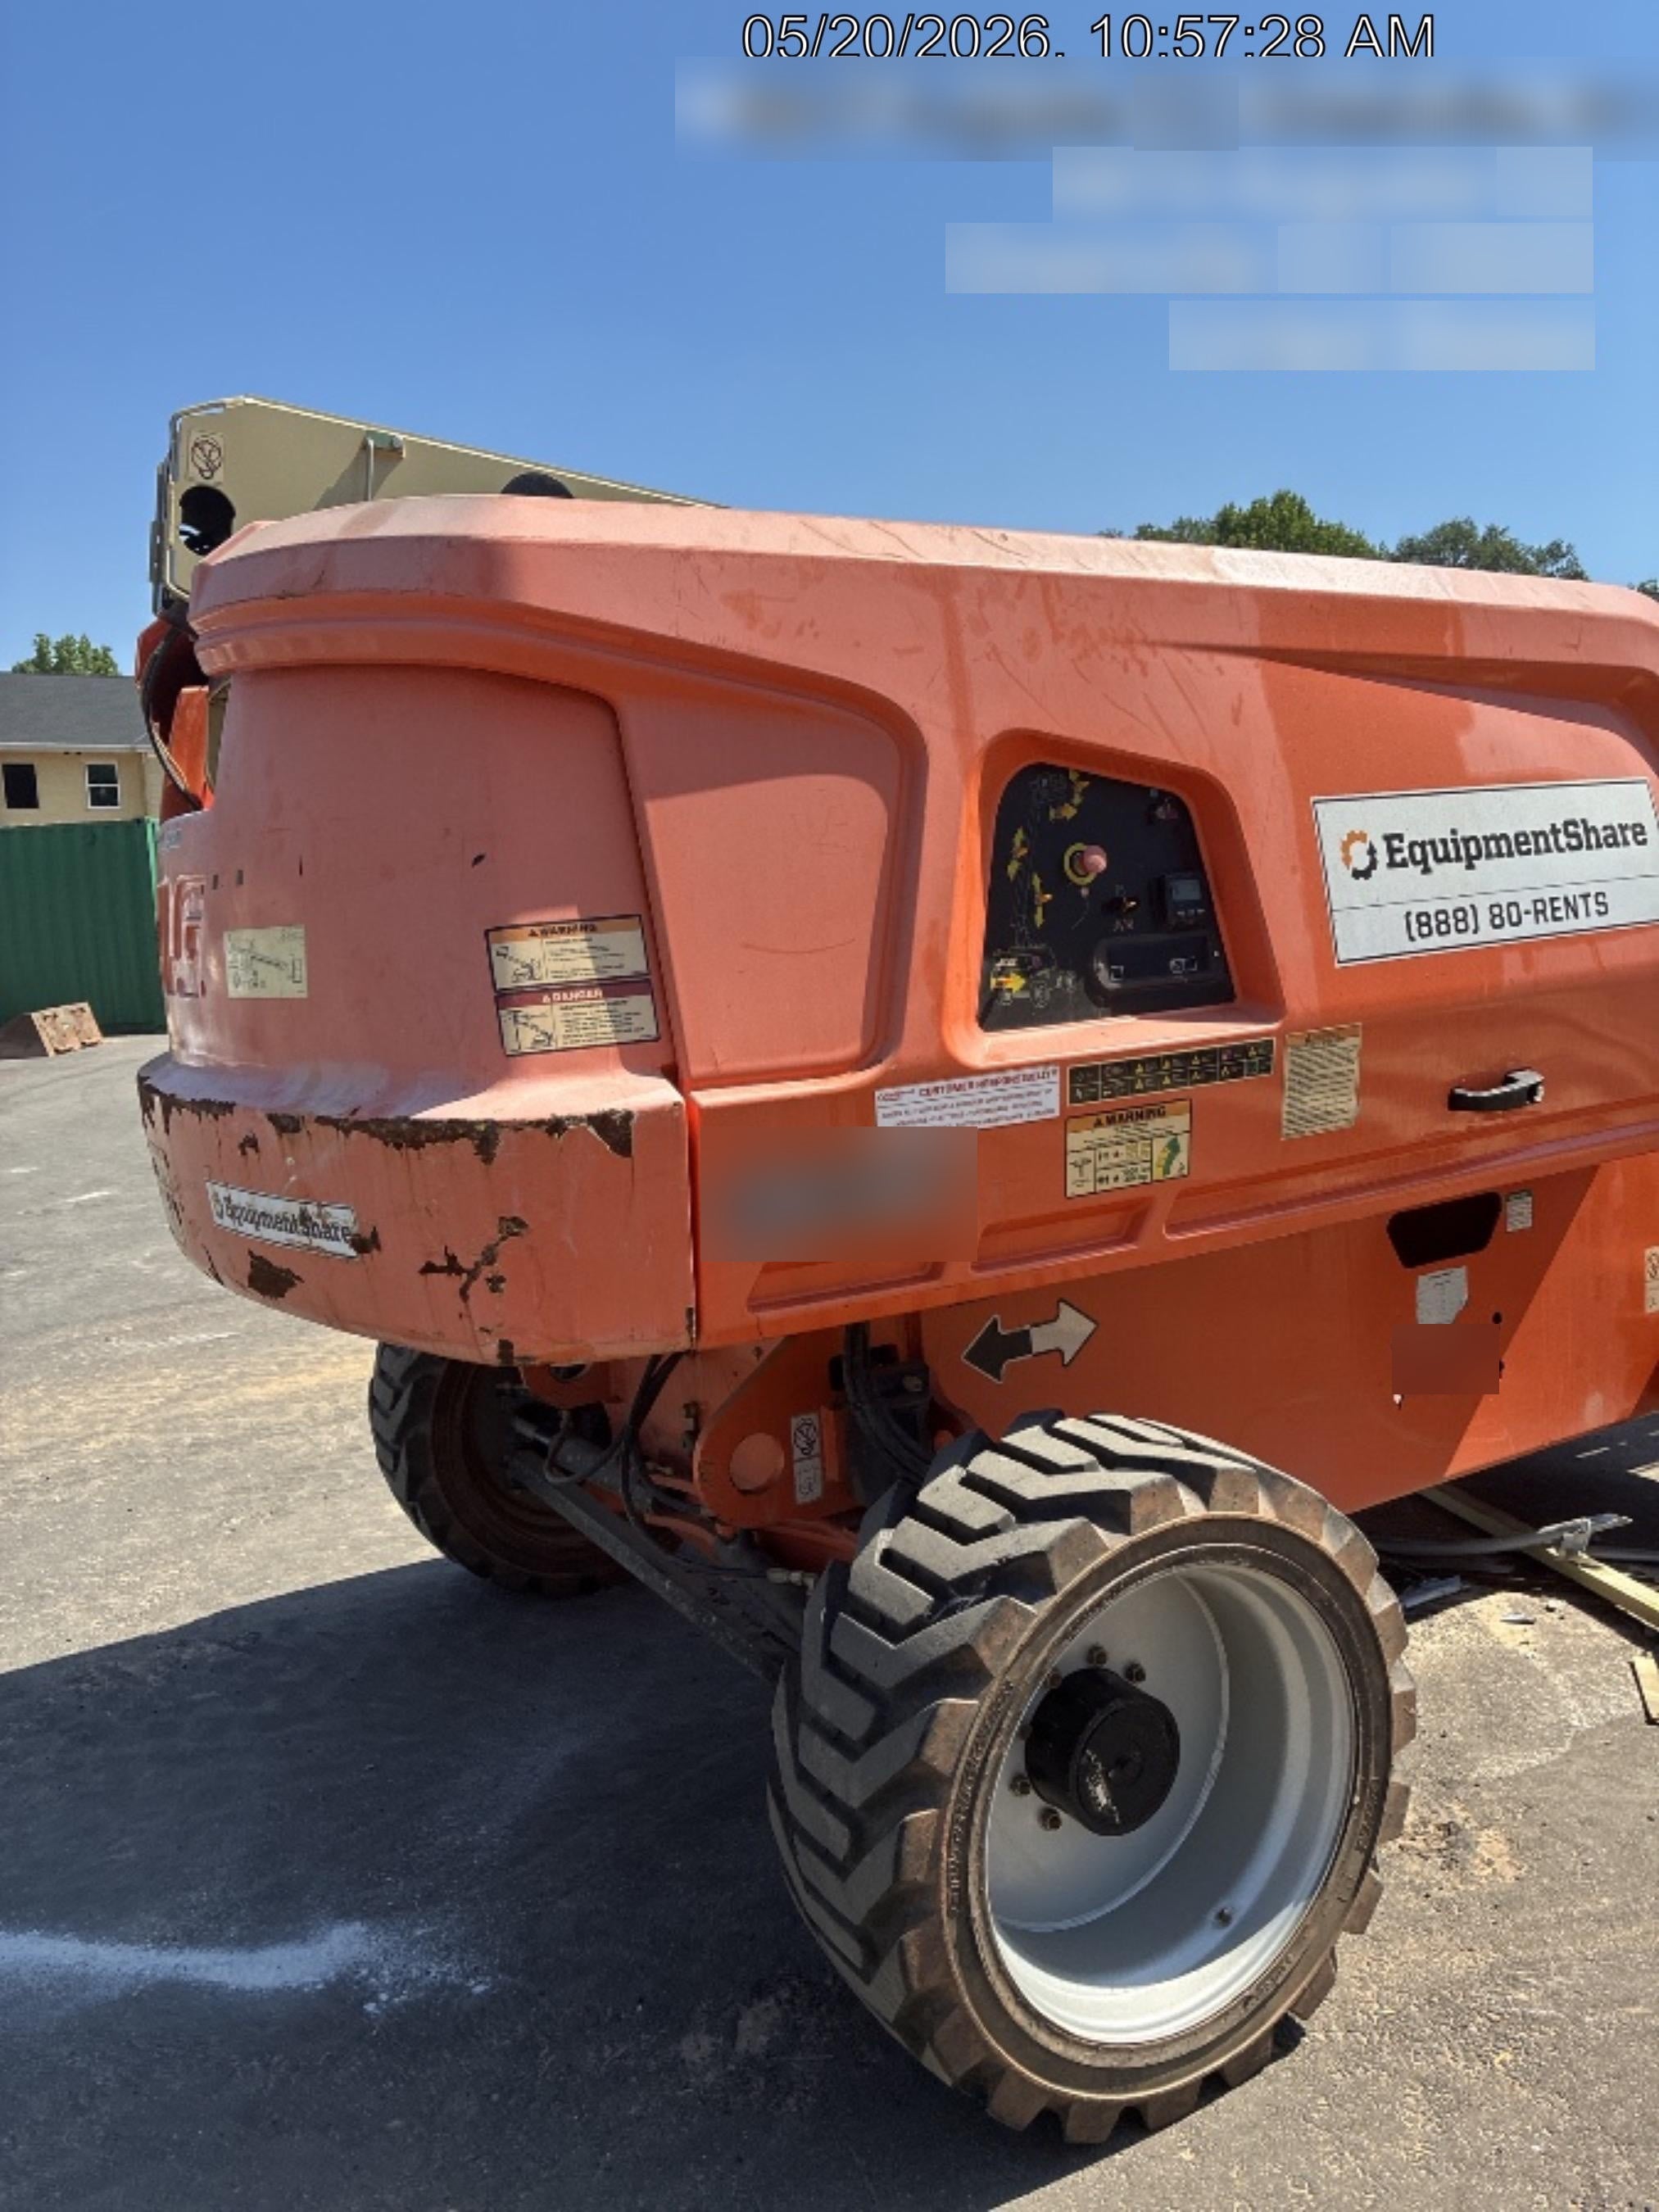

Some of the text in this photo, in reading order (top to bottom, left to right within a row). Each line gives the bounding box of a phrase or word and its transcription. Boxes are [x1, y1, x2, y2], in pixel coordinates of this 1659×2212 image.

[1382, 818, 1648, 875] EquipmentShare
[1404, 891, 1610, 941] (888) 80-RENTS
[552, 988, 604, 1001] DANGER
[1105, 1106, 1167, 1125] WARNING
